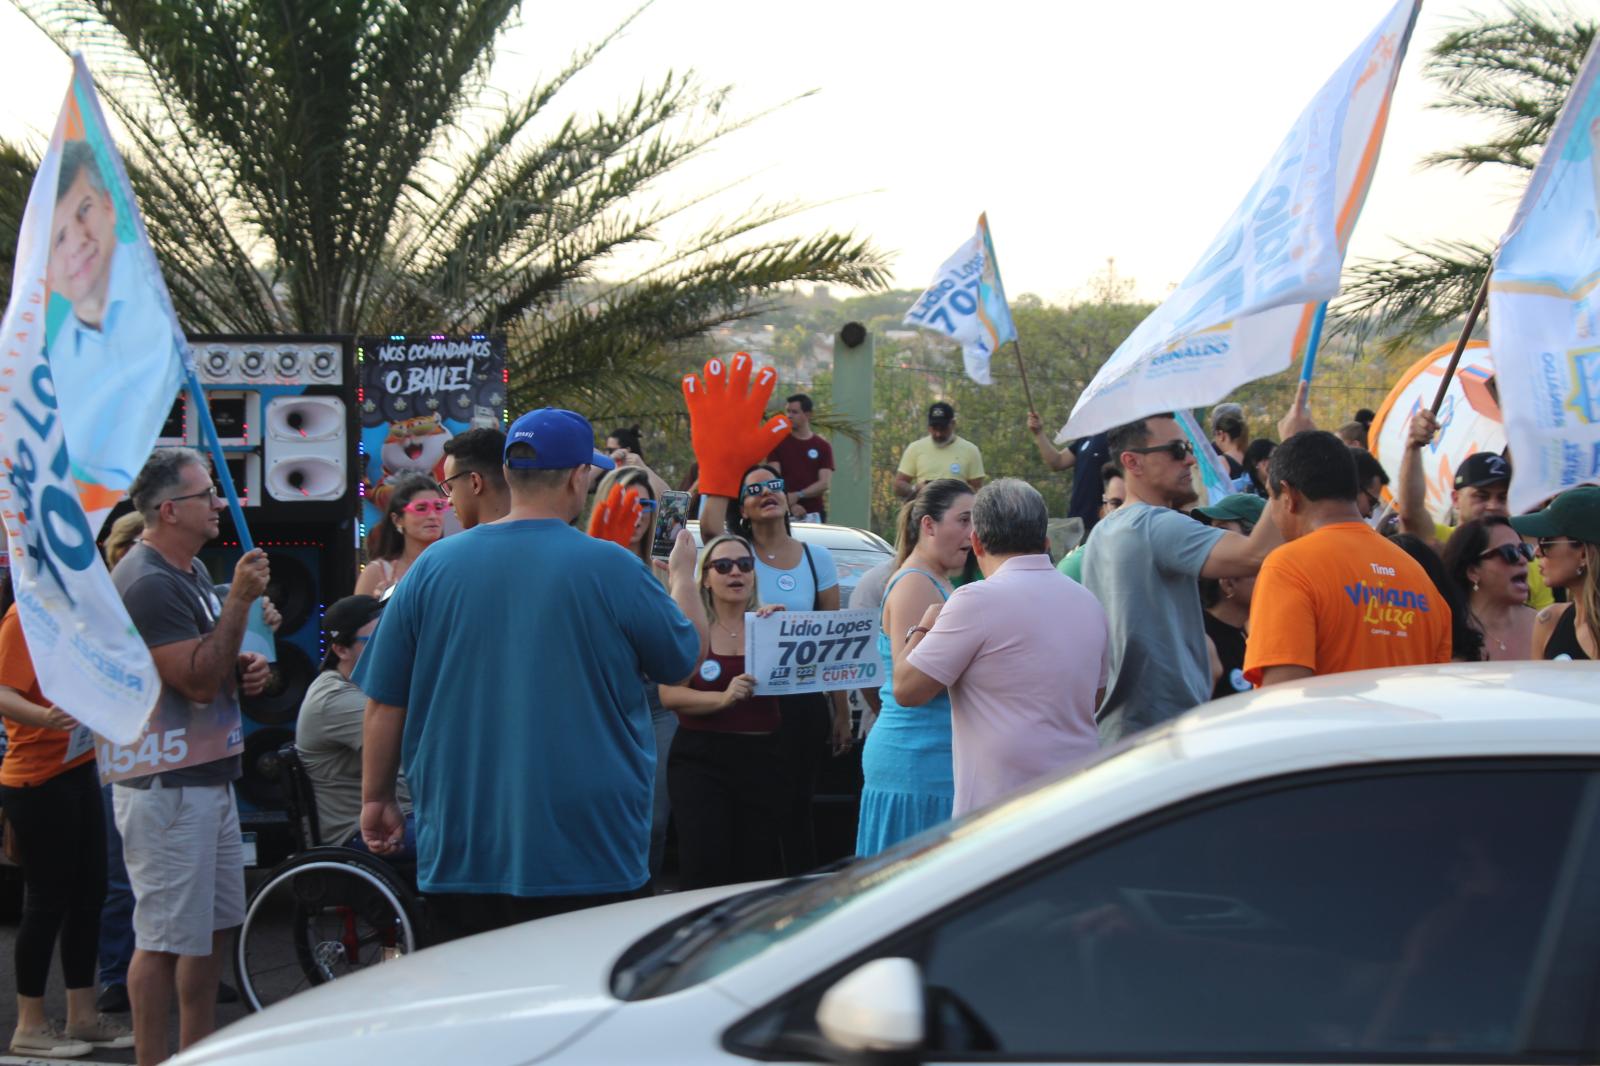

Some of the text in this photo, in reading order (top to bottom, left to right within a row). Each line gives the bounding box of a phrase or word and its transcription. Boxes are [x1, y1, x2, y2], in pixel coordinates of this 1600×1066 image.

[385, 369, 402, 394] O
[1370, 562, 1396, 577] Time
[1343, 579, 1431, 613] Viviane
[1363, 595, 1416, 630] Luiza
[779, 619, 873, 638] Lidio Lopes
[778, 634, 871, 667] 70777
[822, 668, 858, 682] CURY
